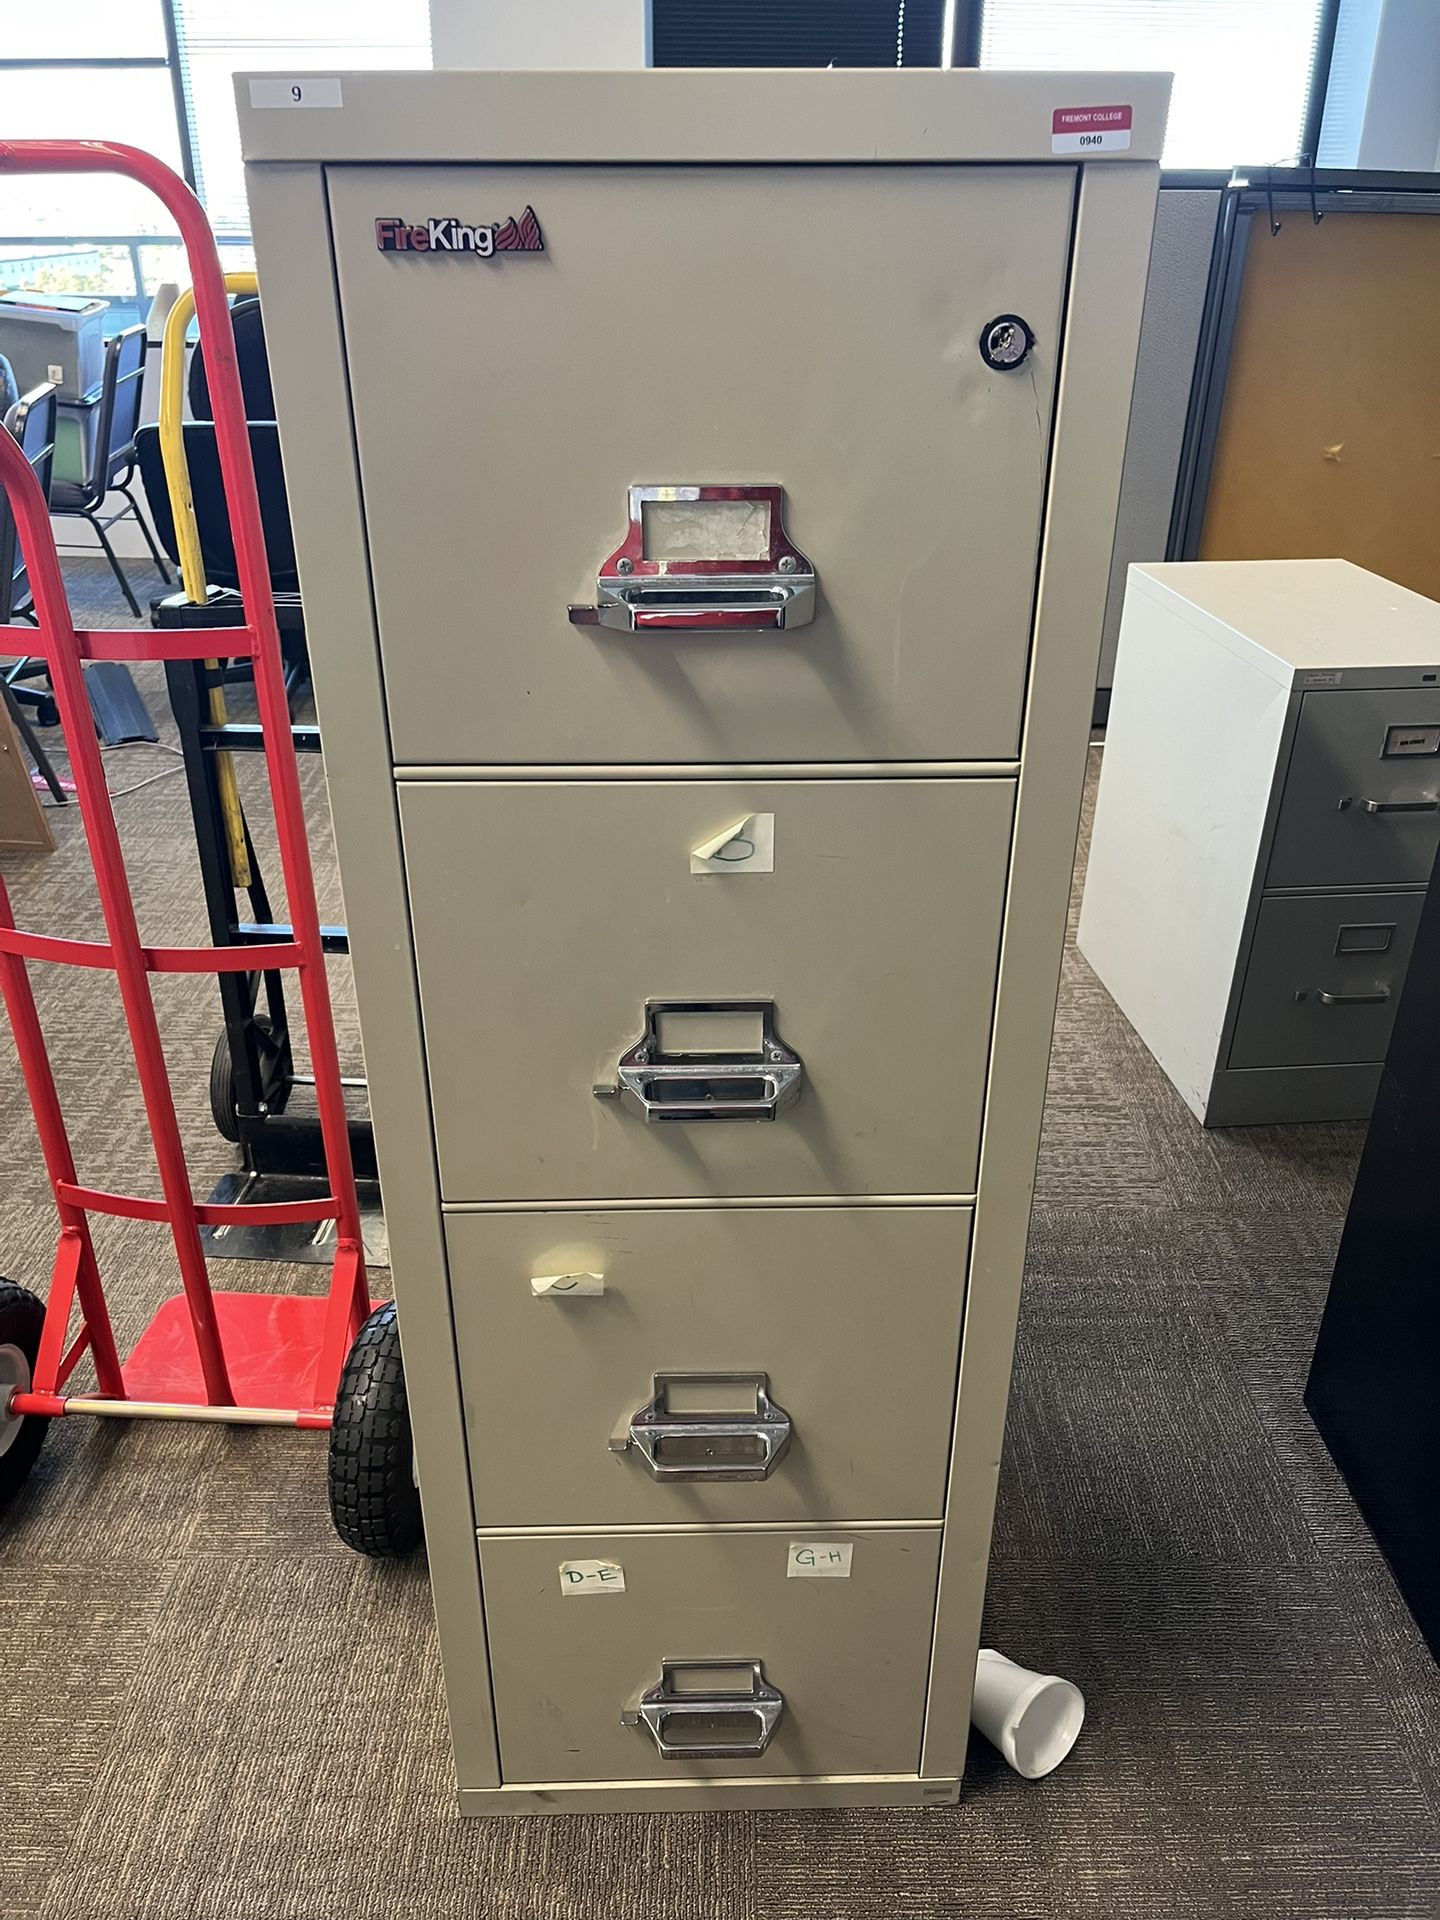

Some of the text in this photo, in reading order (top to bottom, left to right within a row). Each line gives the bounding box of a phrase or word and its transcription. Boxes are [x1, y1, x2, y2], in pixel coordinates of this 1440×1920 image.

[291, 85, 302, 102] 9
[1061, 111, 1123, 123] FREMONT COLLEGE
[1079, 135, 1103, 145] 0940
[375, 217, 495, 257] FireKing
[795, 1548, 842, 1567] G-H
[565, 1568, 618, 1583] D-E
